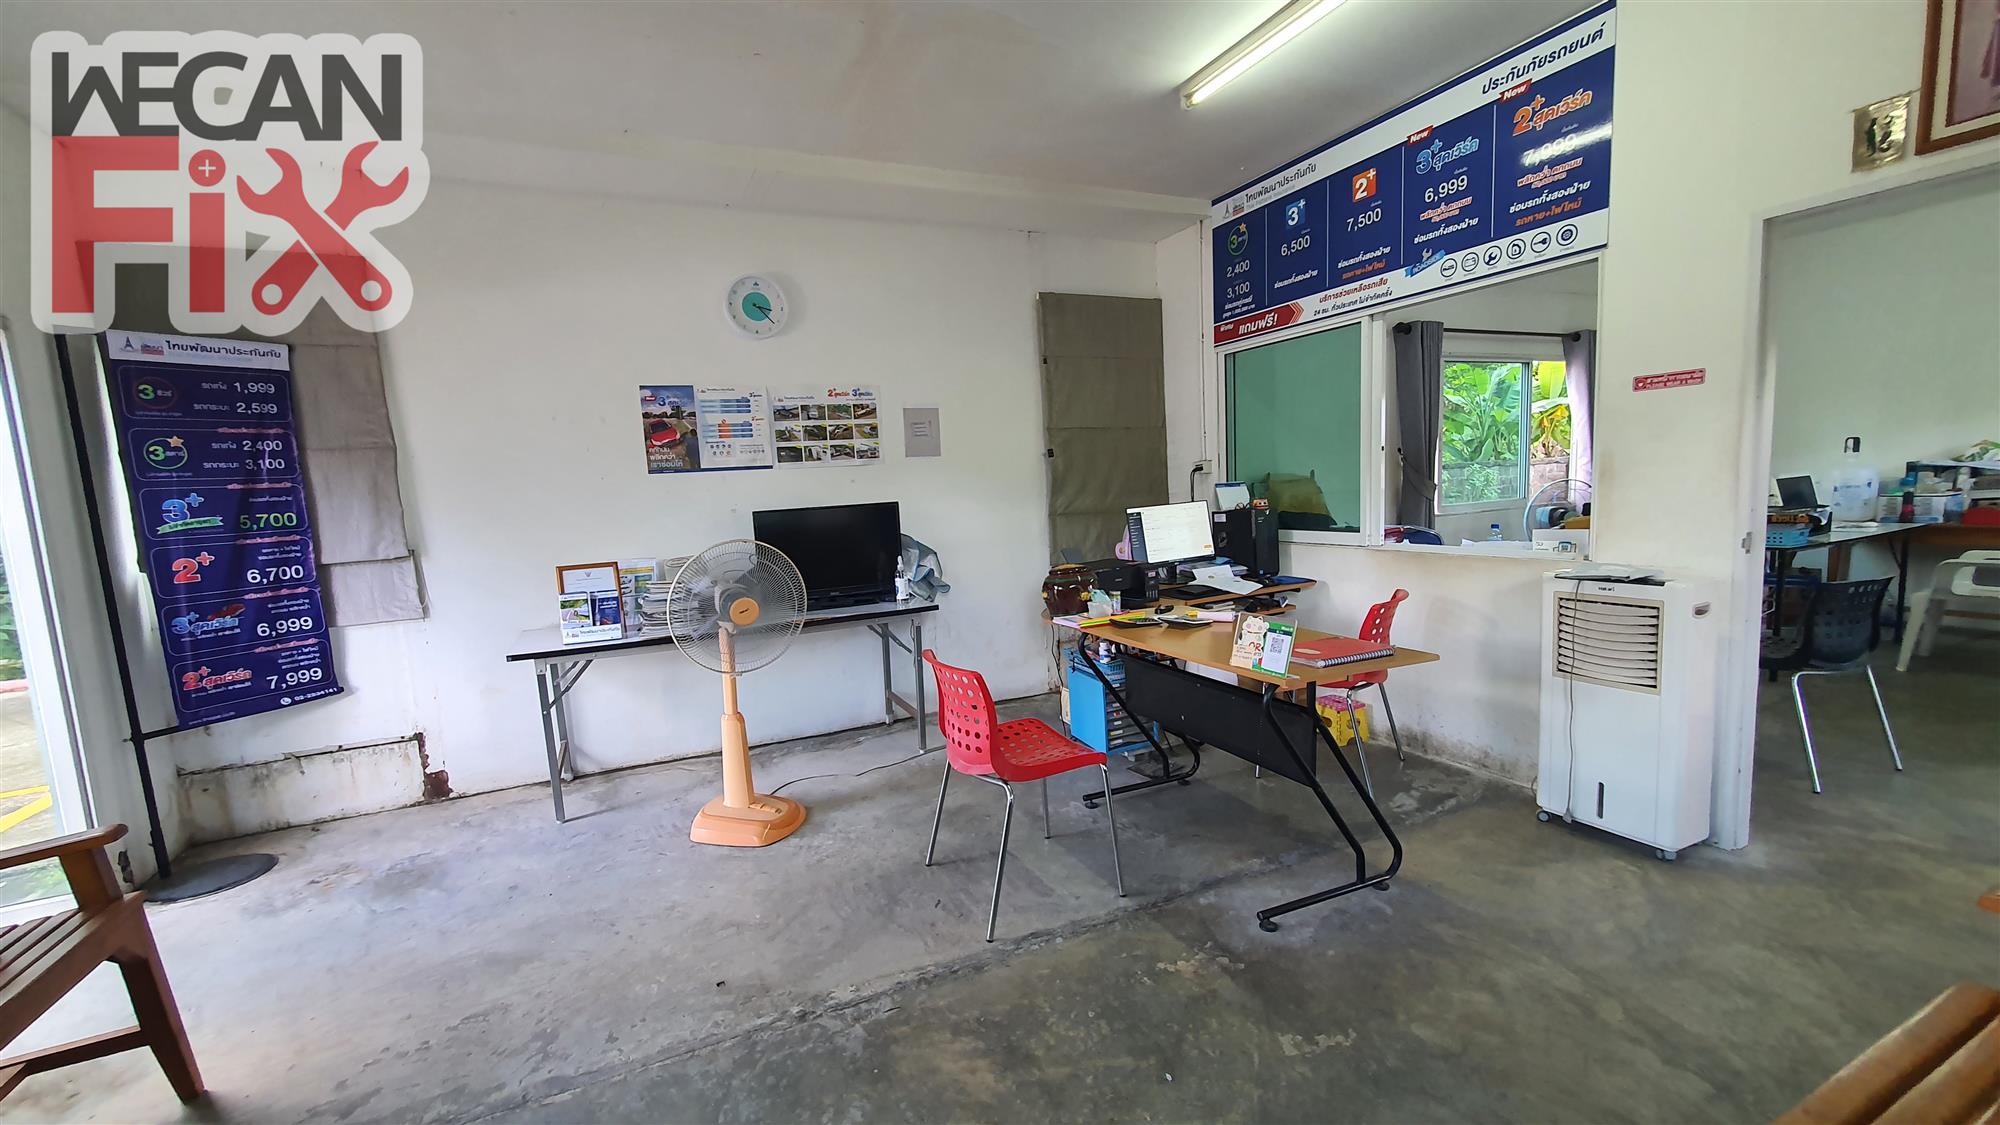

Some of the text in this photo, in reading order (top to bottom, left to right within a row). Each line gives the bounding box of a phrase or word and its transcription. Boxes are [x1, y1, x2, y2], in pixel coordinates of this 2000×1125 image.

[1482, 21, 1606, 94] ประกันภัยรถยนต์
[1503, 84, 1527, 100] New
[1409, 130, 1429, 143] New
[1424, 175, 1468, 203] 6,999
[1509, 180, 1591, 213] ซ่อมรถทั้งสองฝ่าย
[1347, 208, 1382, 232] 7,500
[1281, 235, 1311, 256] 6,500
[1226, 260, 1250, 278] 2,400
[1226, 281, 1250, 299] 3,100
[1239, 311, 1278, 335] แถมฟรี!
[165, 339, 282, 359] ไทยพัฒนาประกันภัย
[137, 384, 156, 400] 3
[233, 382, 275, 394] 1,999
[236, 402, 278, 415] 2,599
[242, 440, 283, 452] 2,400
[245, 458, 286, 472] 3,100
[240, 512, 297, 530] 5,700
[246, 564, 304, 585] 6,700
[256, 616, 313, 637] 6,999
[266, 667, 323, 689] 7,999
